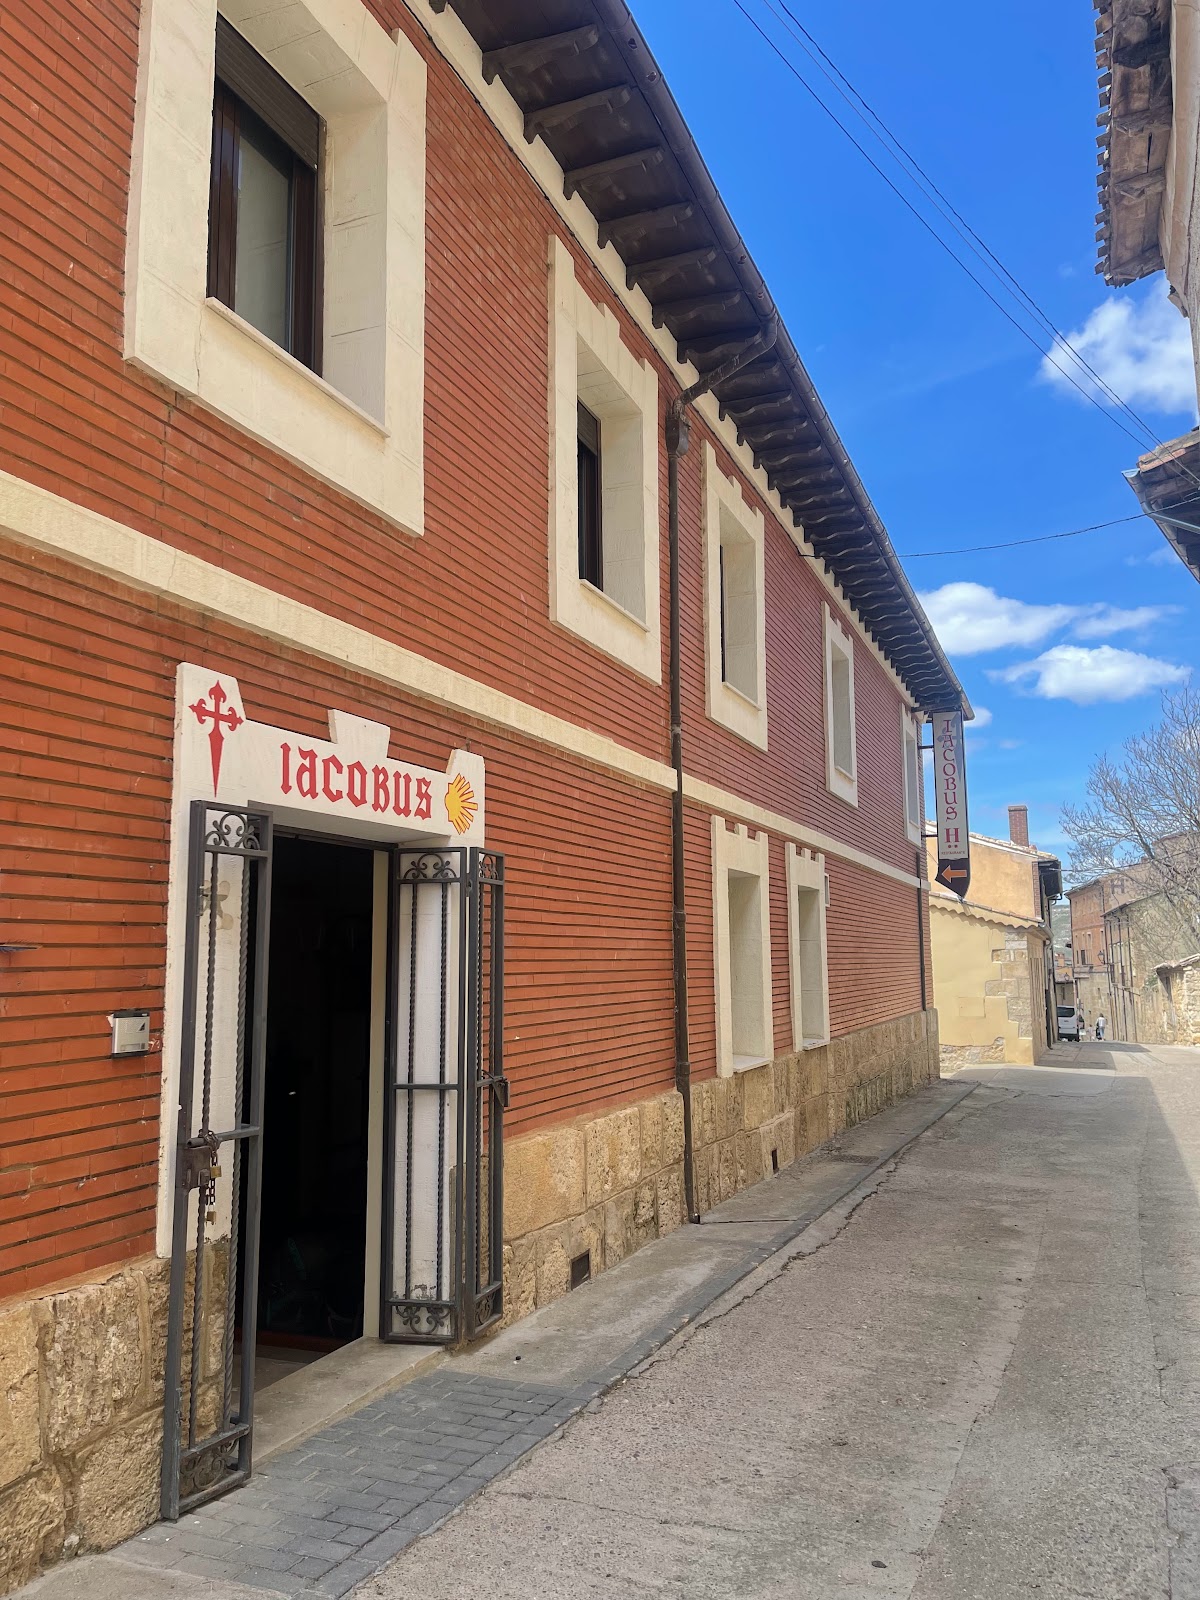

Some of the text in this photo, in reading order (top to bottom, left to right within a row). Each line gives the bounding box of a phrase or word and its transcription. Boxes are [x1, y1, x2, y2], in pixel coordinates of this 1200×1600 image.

[280, 743, 432, 820] IACOBUS
[943, 719, 958, 822] IACOBUS
[945, 828, 960, 844] H
